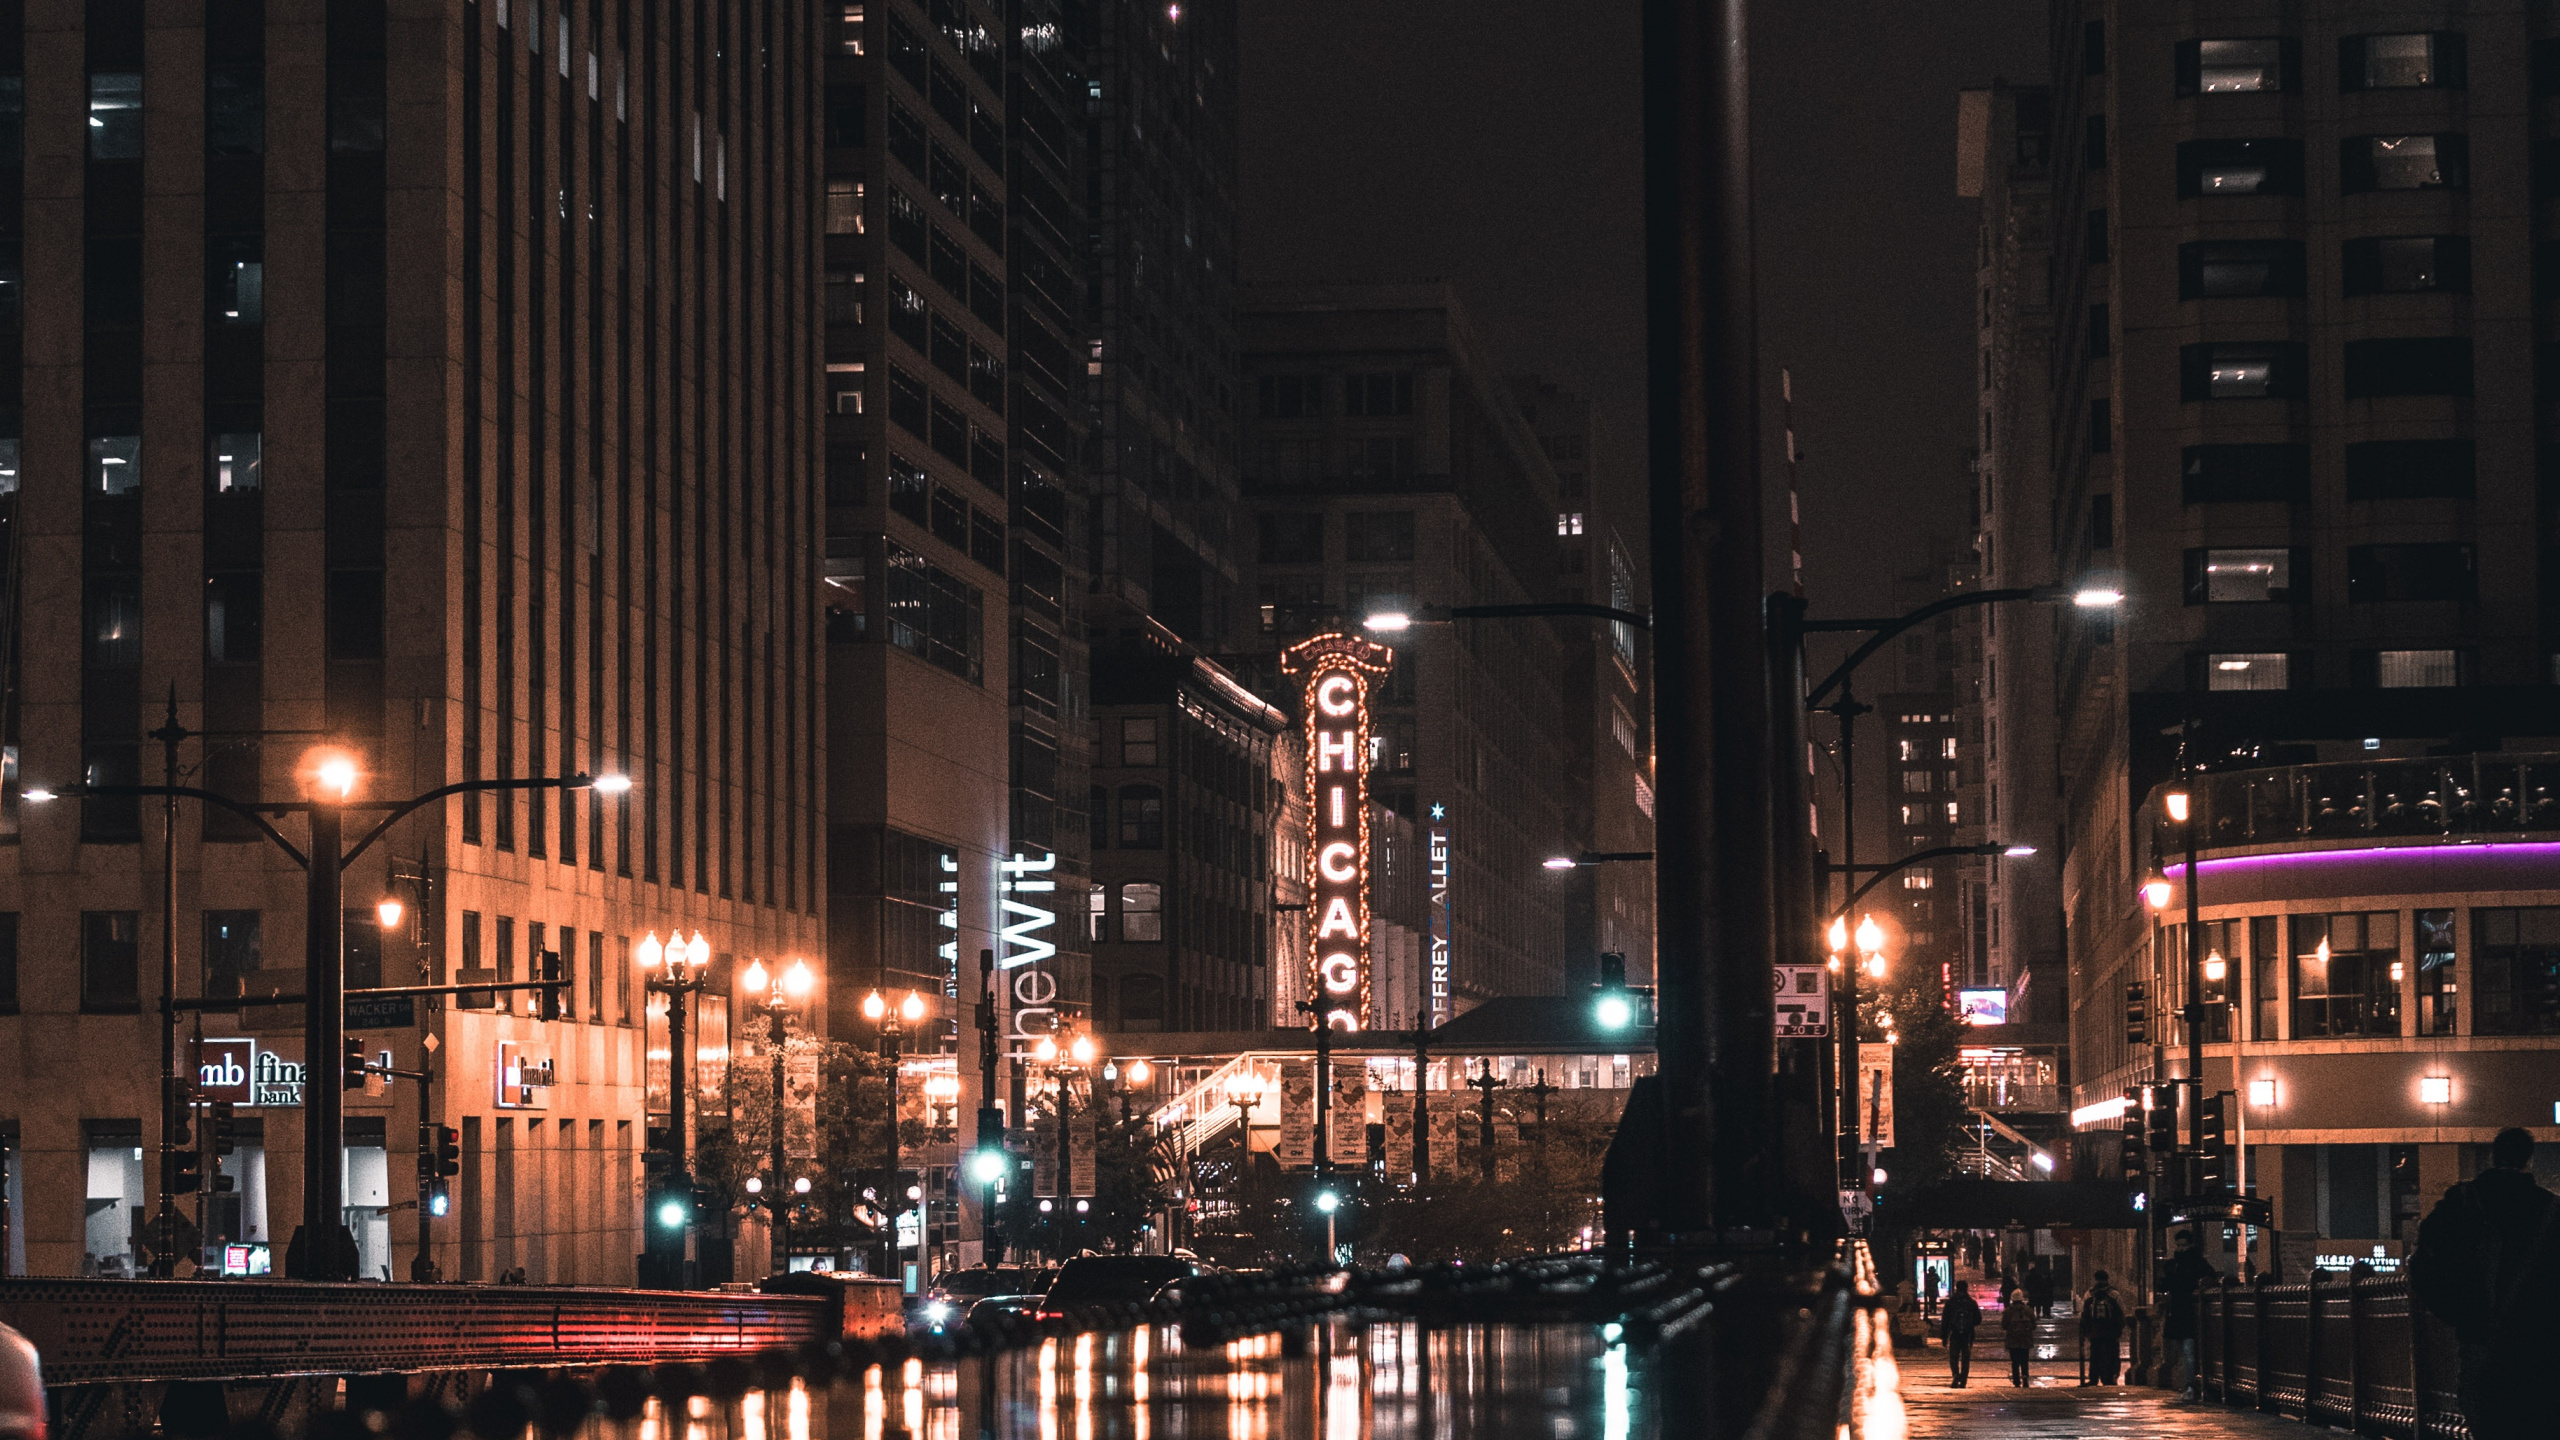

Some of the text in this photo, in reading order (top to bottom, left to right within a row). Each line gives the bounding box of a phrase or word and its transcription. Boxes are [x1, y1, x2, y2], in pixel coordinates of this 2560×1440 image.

[1302, 640, 1355, 660] CHASE
[1432, 830, 1448, 1030] OFFREY ALLET
[348, 1003, 396, 1017] WACKER
[1790, 1026, 1820, 1035] ZOE
[200, 1052, 245, 1086] mb
[257, 1086, 302, 1104] bank
[1843, 1195, 1858, 1204] NO
